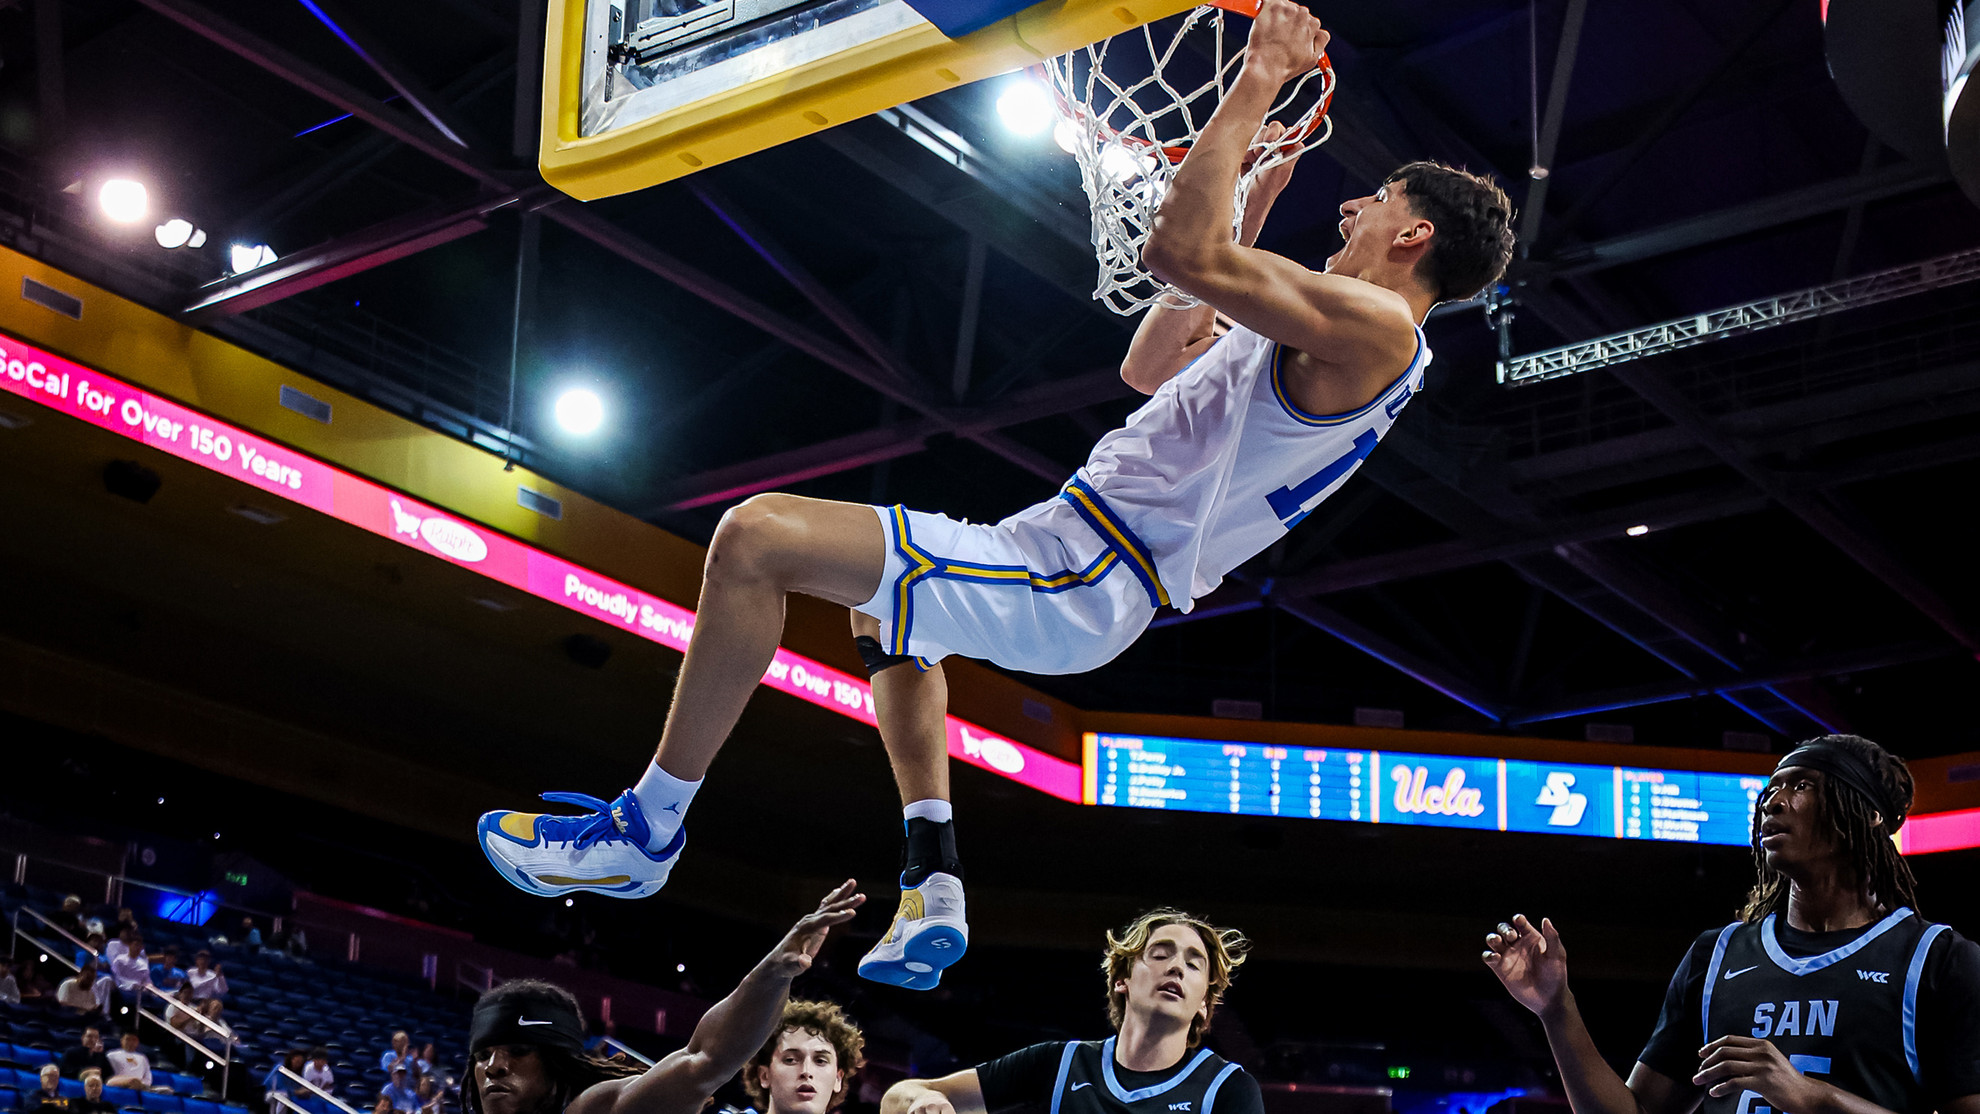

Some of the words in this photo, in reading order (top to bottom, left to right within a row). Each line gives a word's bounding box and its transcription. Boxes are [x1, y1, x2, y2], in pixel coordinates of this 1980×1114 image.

[77, 380, 115, 416] for
[121, 399, 184, 442] Over
[189, 425, 232, 461] 150
[238, 444, 303, 490] Years
[1265, 427, 1379, 530] 1
[564, 573, 638, 624] Proudly
[640, 604, 695, 643] Servin
[767, 660, 790, 681] or
[791, 664, 832, 697] Over
[833, 680, 862, 709] 150
[1856, 969, 1890, 984] WCC
[1752, 999, 1839, 1039] SAN
